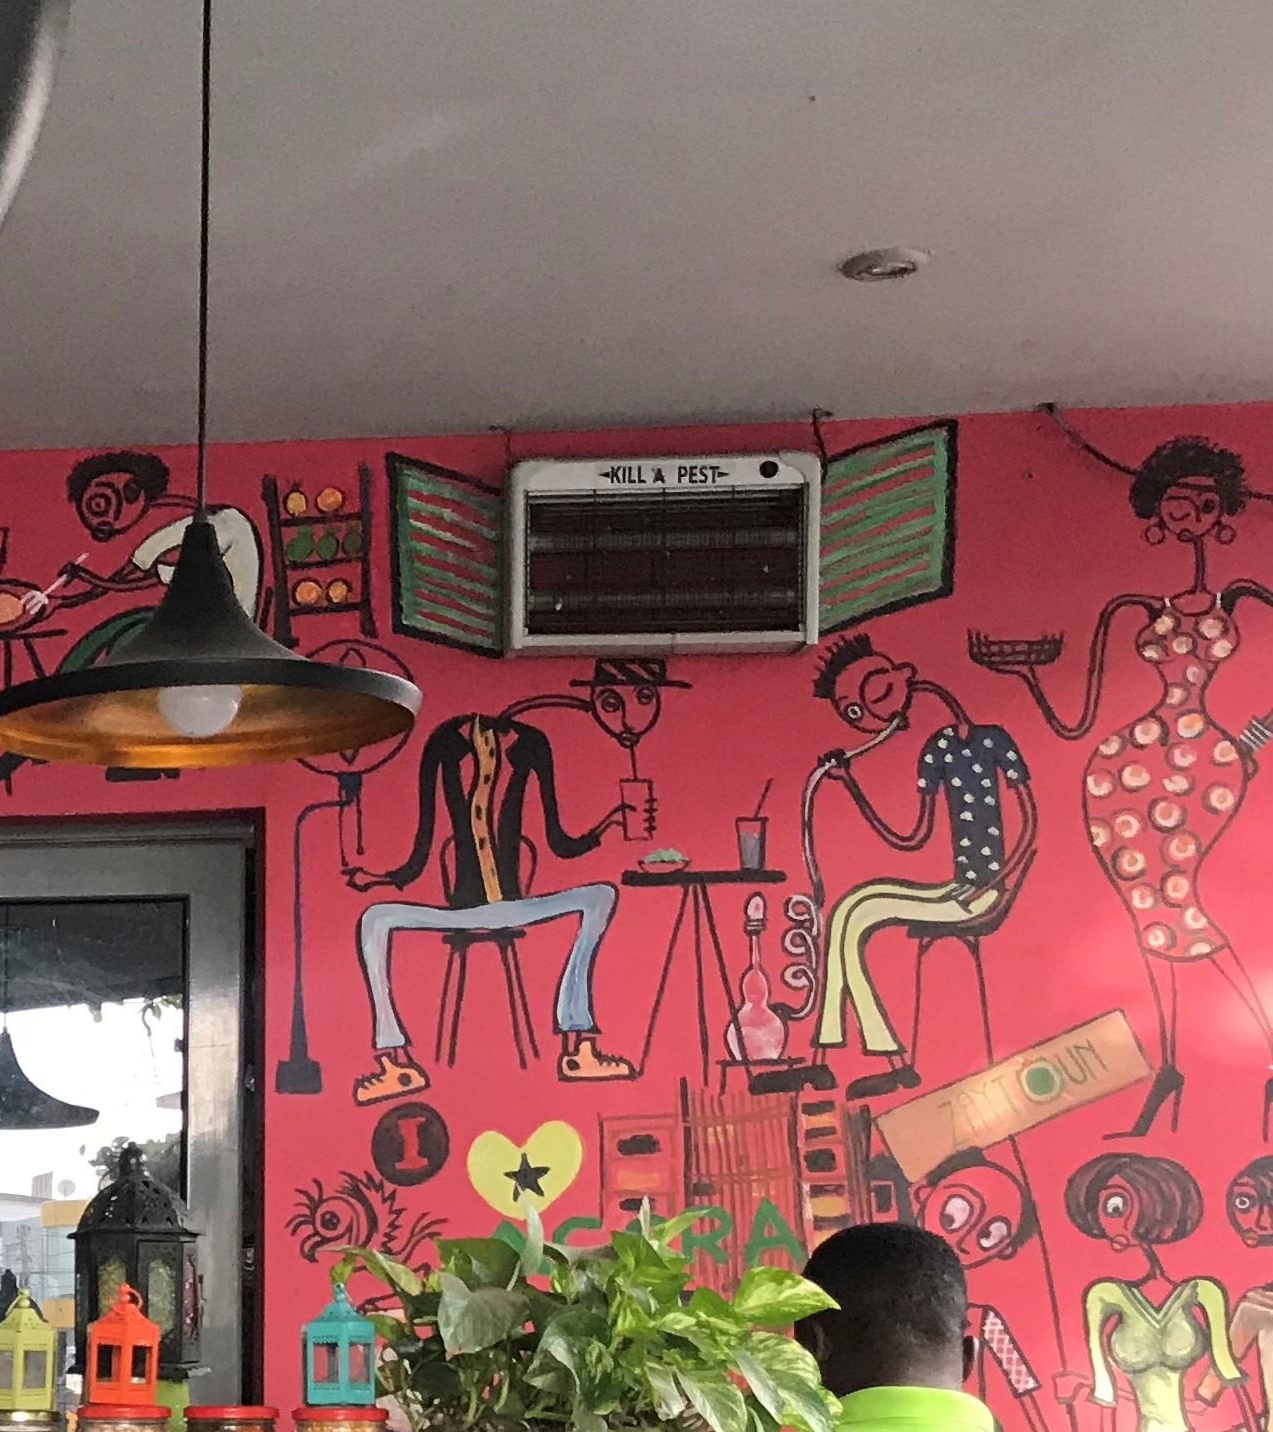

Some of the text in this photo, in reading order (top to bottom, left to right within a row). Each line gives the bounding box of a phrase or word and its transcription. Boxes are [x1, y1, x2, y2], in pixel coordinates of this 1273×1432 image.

[610, 466, 647, 484] KILL
[677, 466, 720, 484] PEST
[937, 1038, 1110, 1148] ZAYTOUN
[395, 1116, 430, 1170] I
[491, 1197, 807, 1276] CRA
